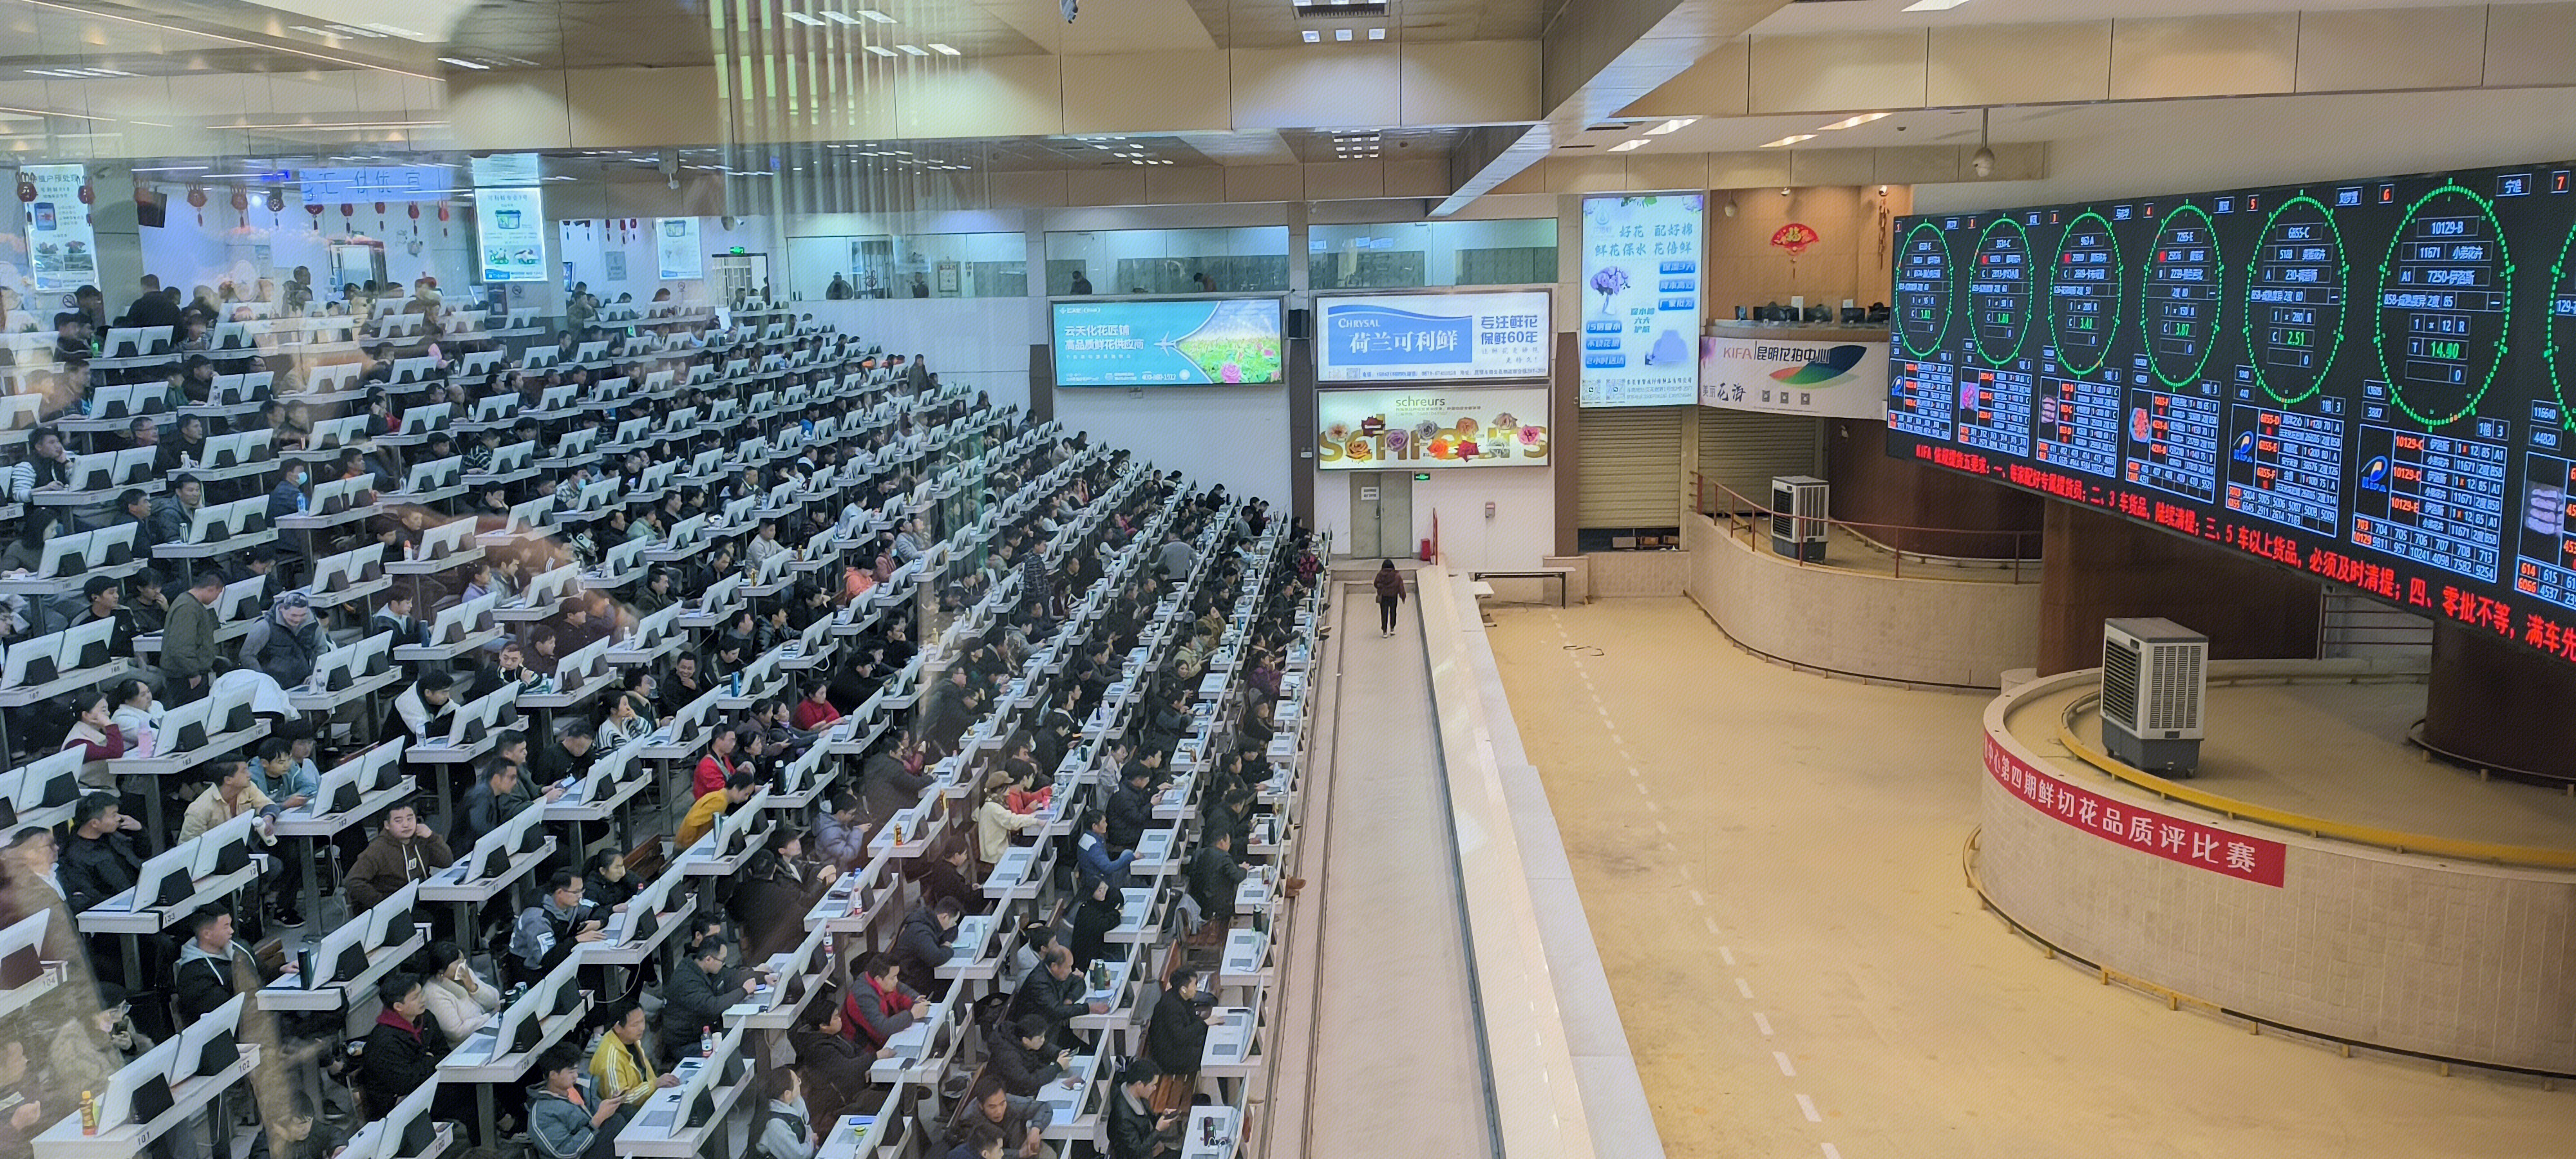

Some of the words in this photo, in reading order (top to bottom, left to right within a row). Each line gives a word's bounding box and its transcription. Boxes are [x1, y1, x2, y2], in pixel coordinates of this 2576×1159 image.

[2557, 176, 2564, 190] 7
[2383, 189, 2389, 200] 6
[2251, 199, 2255, 209] 5
[1619, 224, 1644, 238] 好花
[1654, 222, 1693, 237] 配好棉
[2432, 221, 2463, 234] 10129-B
[1595, 243, 1646, 257] 鲜花保水
[2420, 247, 2441, 258] 11671
[2401, 271, 2411, 282] A1
[1338, 318, 1381, 328] CHRYSAL
[1481, 315, 1538, 329] 专注鲜花
[2442, 320, 2451, 332] 12
[2459, 321, 2465, 332] R
[1065, 325, 1130, 336] 云天化花匠铺
[1065, 338, 1144, 350] 高品质鲜花供应商
[1349, 330, 1458, 353] 荷兰可利鲜
[1481, 331, 1538, 344] 保鲜60年
[2287, 332, 2304, 345] 2.51
[1723, 347, 1752, 360] KIFA
[2412, 342, 2419, 353] T
[1757, 346, 1830, 364] 昆明花拍中心
[2455, 370, 2461, 381] 0
[1396, 395, 1445, 407] schreurs
[2334, 423, 2340, 432] A
[2497, 426, 2503, 437] 3
[2396, 436, 2423, 451] 10129-C
[2333, 453, 2338, 462] A
[2470, 446, 2479, 456] 12
[2494, 450, 2504, 460] A1
[2457, 460, 2475, 472] 11671
[2331, 481, 2336, 491] A
[2467, 478, 2476, 489] 12
[2491, 483, 2501, 494] A1
[2454, 492, 2472, 505] 11671
[2287, 514, 2300, 525] 7183
[2465, 511, 2473, 521] 12
[2488, 517, 2497, 527] A1
[2451, 525, 2470, 538] 11671
[2357, 519, 2369, 530] 703
[2374, 523, 2388, 535] 704
[2395, 529, 2407, 540] 705
[2415, 534, 2428, 546] 706
[2436, 540, 2449, 551] 707
[2457, 545, 2470, 557] 708
[2479, 551, 2492, 563] 713
[2354, 532, 2371, 545] 10129
[2372, 536, 2388, 549] 9811
[2394, 542, 2406, 554] 957
[2410, 547, 2430, 560] 10241
[2431, 552, 2450, 566] 4098
[2454, 559, 2471, 572] 7582
[2476, 565, 2493, 578] 9254
[2521, 563, 2536, 576] 614
[2543, 569, 2557, 584] 615
[2517, 578, 2537, 593] 6066
[2539, 584, 2559, 600] 4537
[43, 976, 55, 988] 104
[239, 1060, 250, 1073] 102
[138, 1131, 149, 1145] 101
